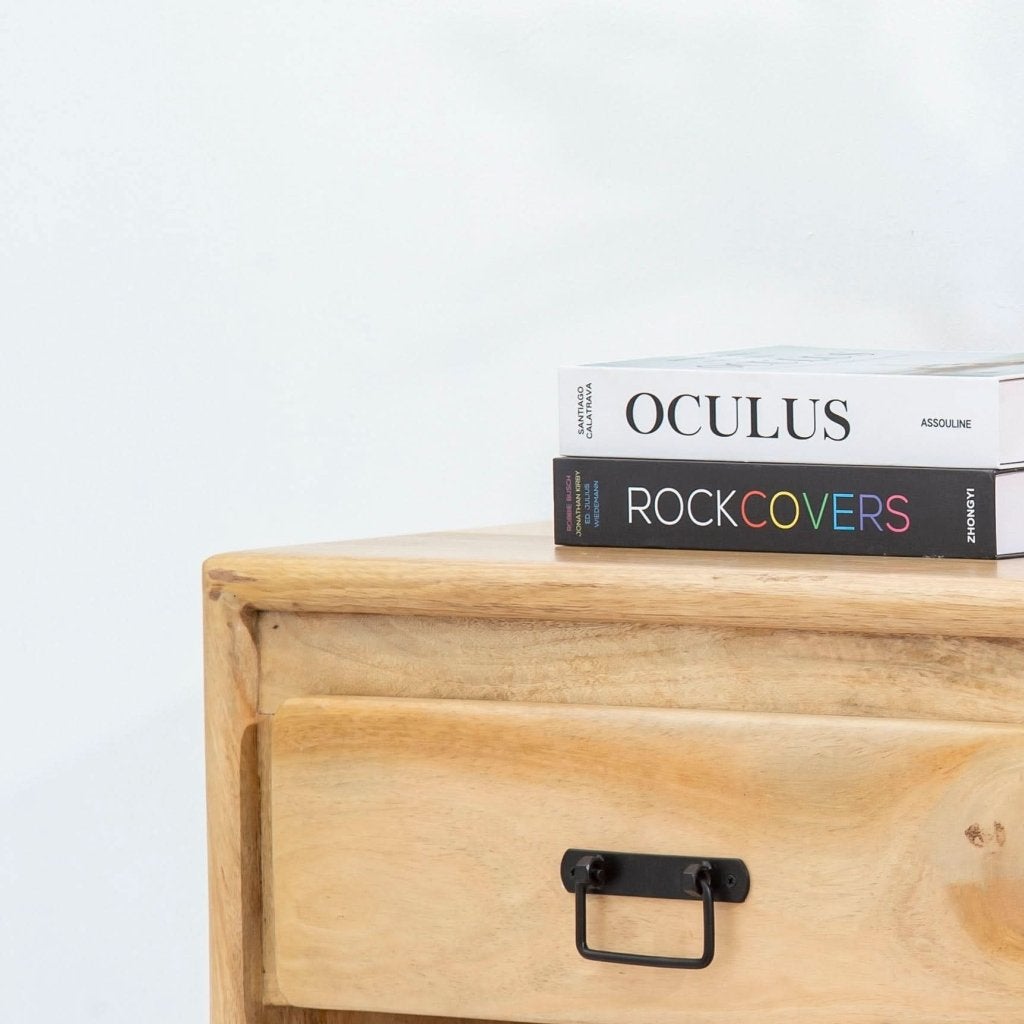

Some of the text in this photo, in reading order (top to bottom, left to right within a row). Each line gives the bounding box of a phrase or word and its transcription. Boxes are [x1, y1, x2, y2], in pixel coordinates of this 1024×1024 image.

[625, 391, 852, 441] OCULUS
[920, 418, 972, 429] ASSOULINE
[966, 488, 976, 544] ZHONGYI
